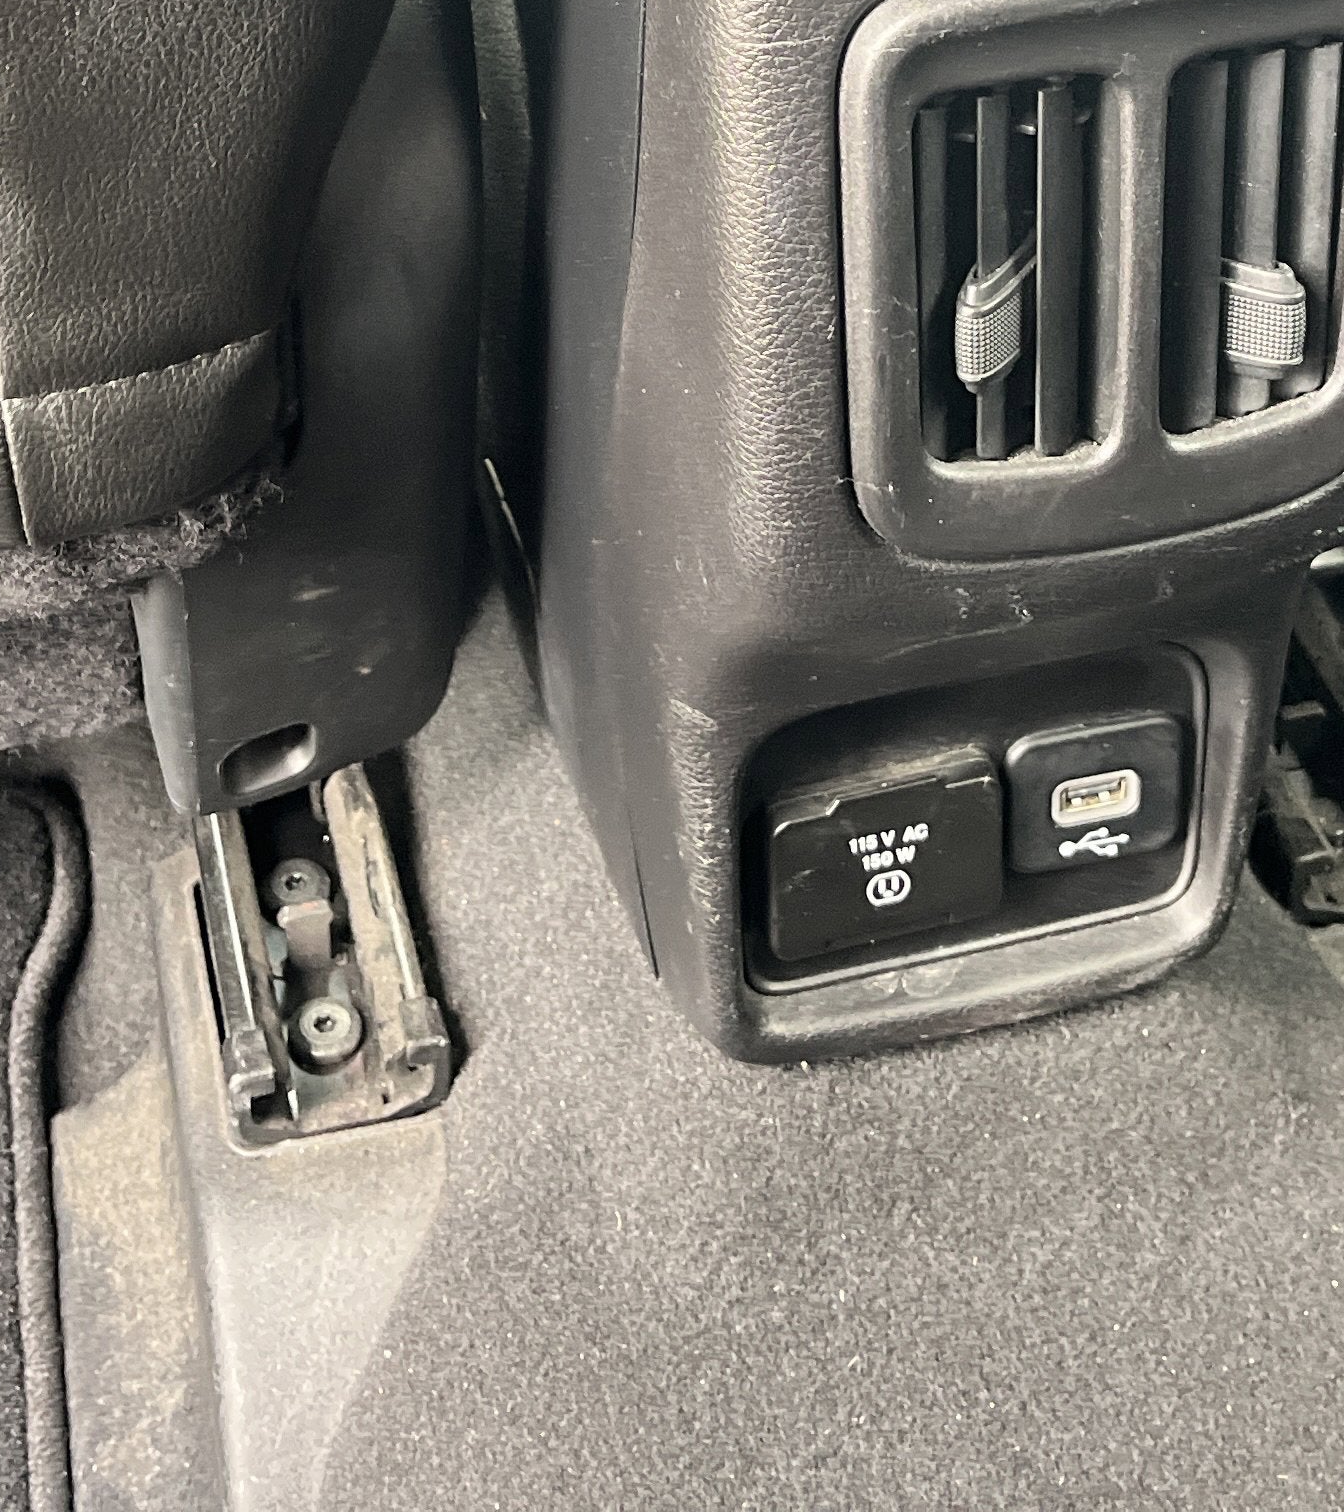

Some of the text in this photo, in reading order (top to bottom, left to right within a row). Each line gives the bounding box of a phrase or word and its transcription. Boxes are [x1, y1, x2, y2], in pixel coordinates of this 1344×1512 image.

[848, 823, 929, 854] 115 V AC
[861, 844, 916, 872] 150 W
